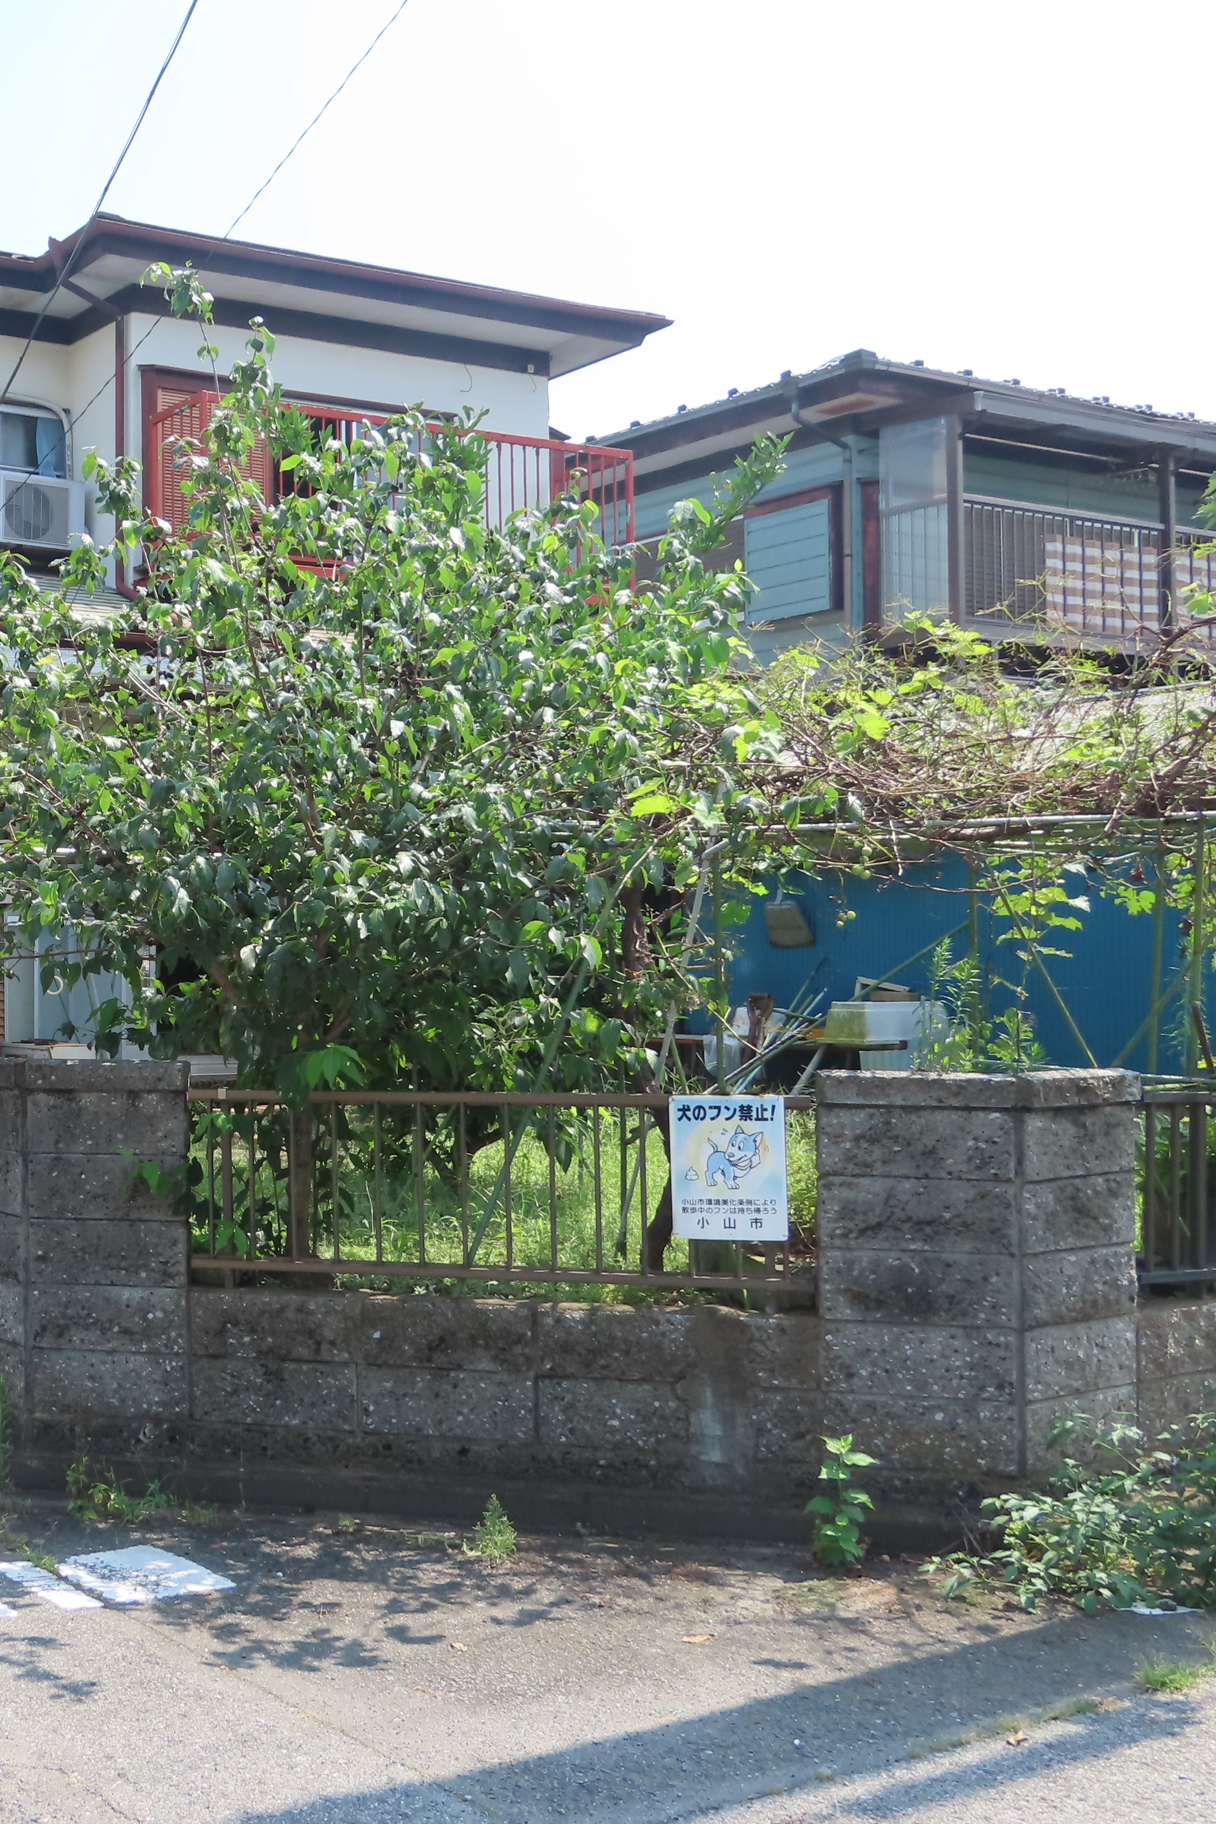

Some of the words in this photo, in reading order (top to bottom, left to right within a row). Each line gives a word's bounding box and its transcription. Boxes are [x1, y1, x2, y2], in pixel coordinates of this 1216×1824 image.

[676, 1104, 776, 1122] 犬のフン禁止!
[681, 1198, 777, 1206] 小山市環境美化条例により
[681, 1206, 778, 1215] 散歩中のフンは持ち帰ろう
